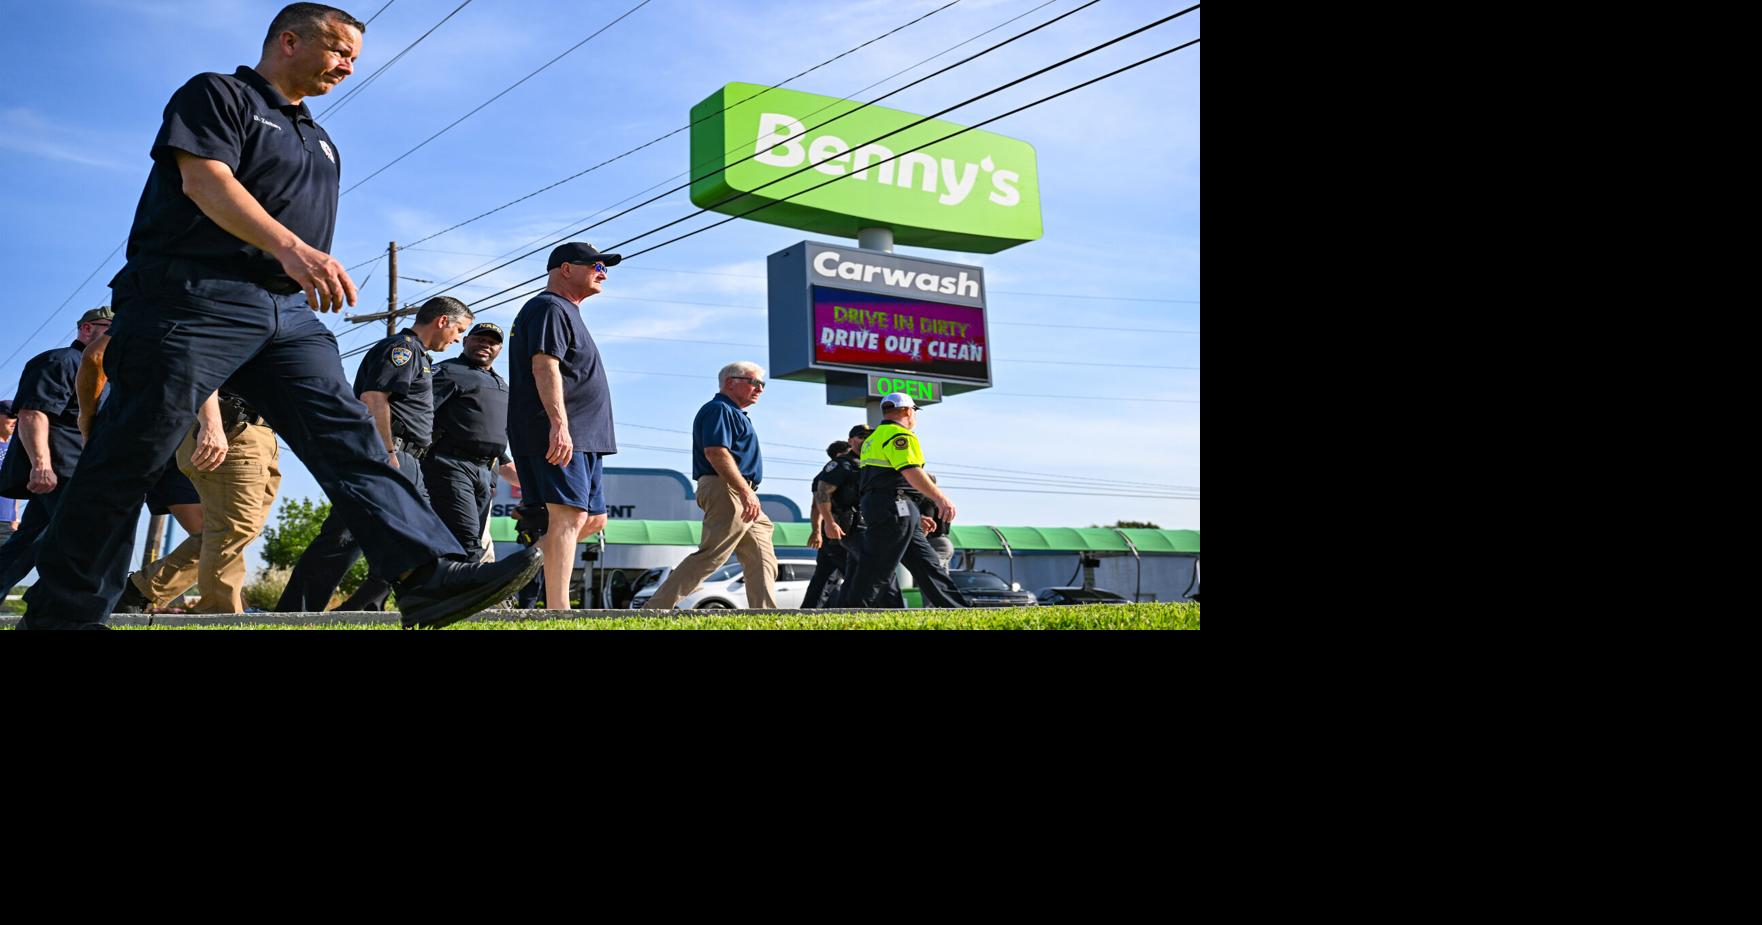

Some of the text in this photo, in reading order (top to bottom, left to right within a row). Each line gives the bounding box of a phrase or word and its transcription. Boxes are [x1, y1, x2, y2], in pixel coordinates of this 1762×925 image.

[753, 112, 1021, 207] Benny's
[813, 251, 980, 298] Carwash
[834, 306, 968, 338] DRIVE IN DIRTY
[820, 327, 983, 362] DRIVE OUT CLEAN
[877, 377, 933, 400] OPEN
